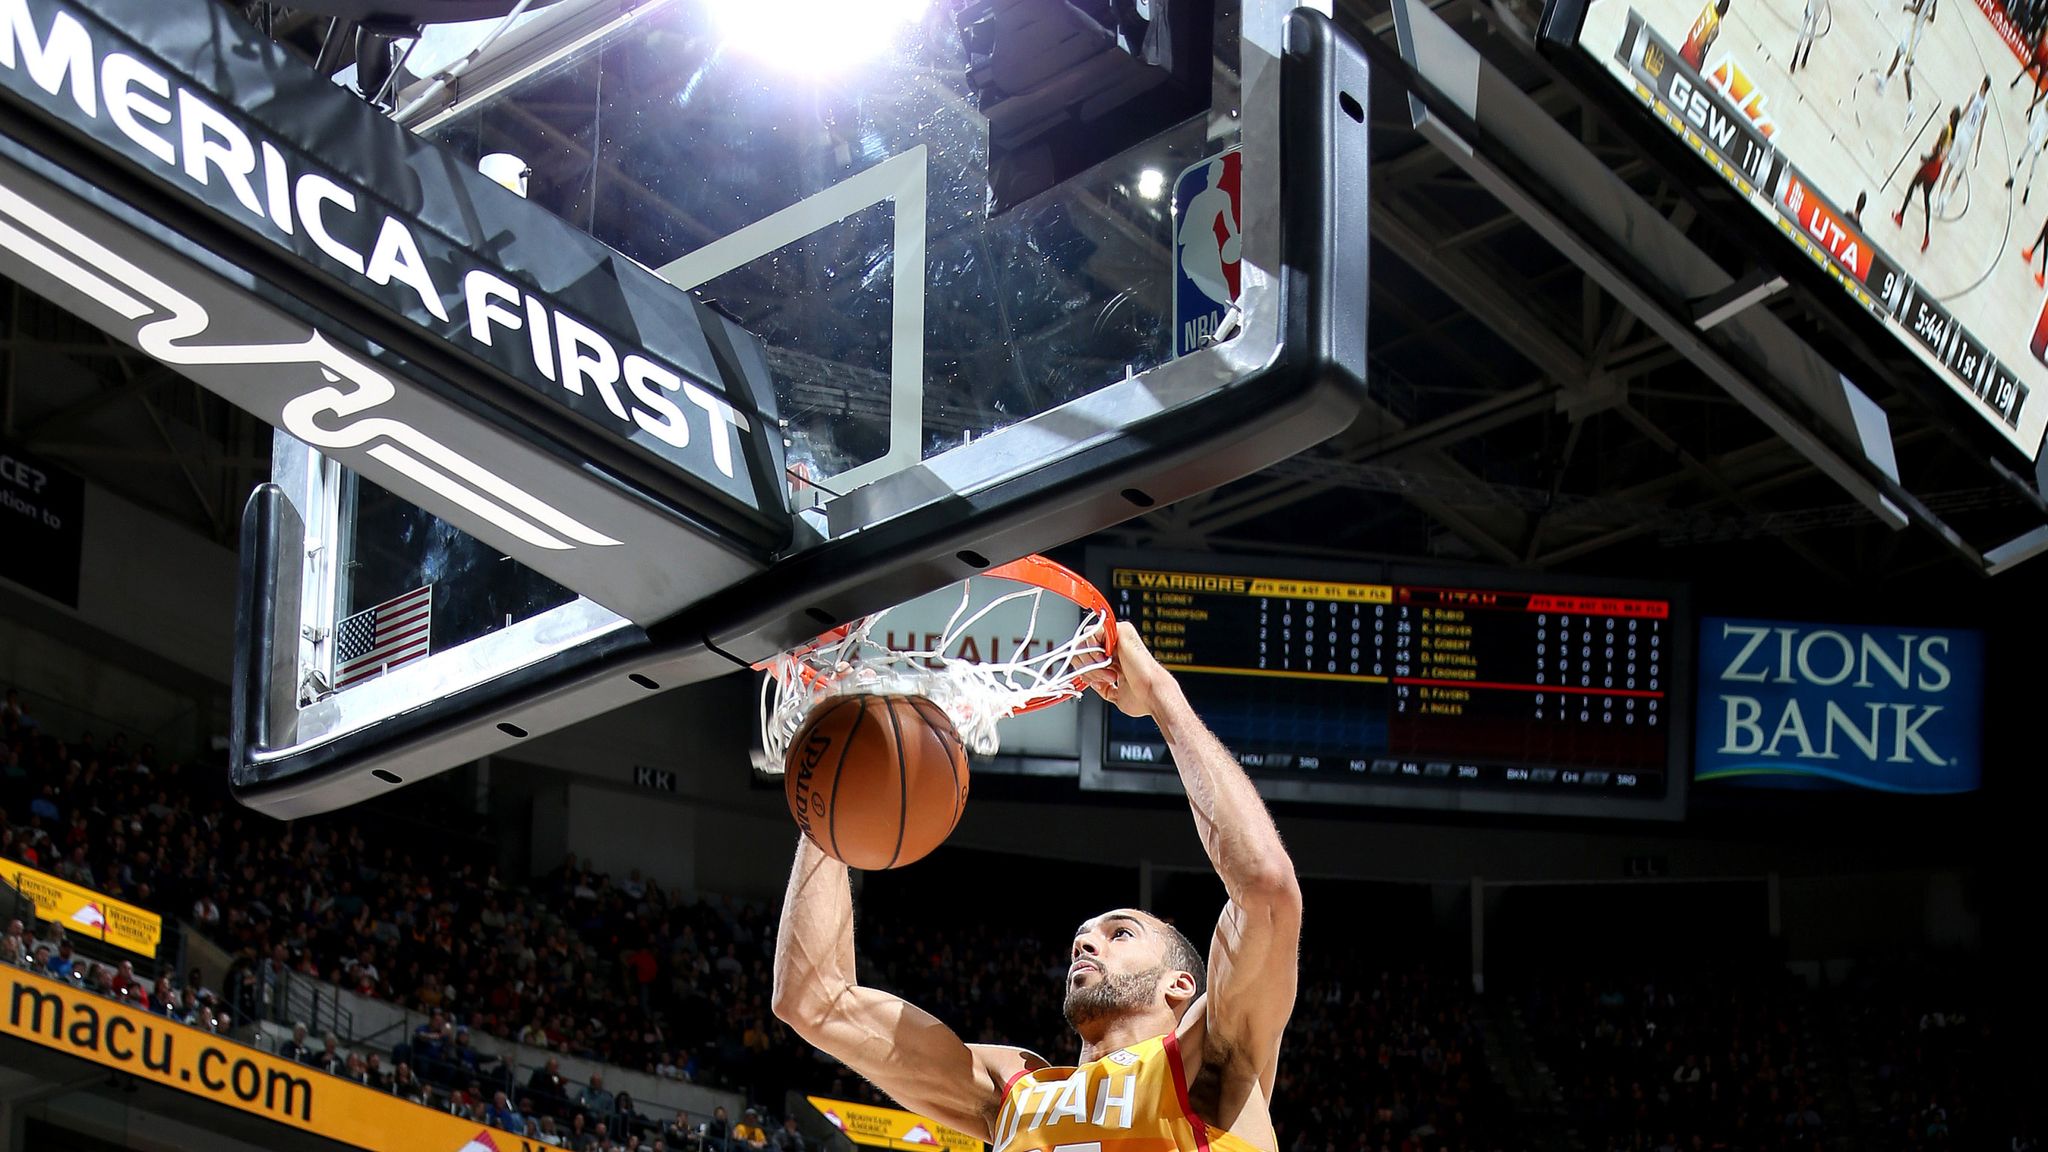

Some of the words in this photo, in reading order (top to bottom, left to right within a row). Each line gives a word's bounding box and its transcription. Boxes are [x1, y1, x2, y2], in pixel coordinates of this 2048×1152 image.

[1667, 71, 1737, 150] GSW
[1742, 145, 1762, 180] 11
[1809, 207, 1859, 275] UTA
[1881, 272, 1896, 300] 9
[1184, 310, 1219, 352] NBA
[1914, 301, 1945, 346] 5:44
[1954, 341, 1977, 379] 1st
[1994, 376, 2013, 410] 19
[464, 269, 750, 480] FIRST
[0, 488, 36, 518] tion
[42, 507, 60, 529] to
[1138, 573, 1246, 592] WARRIORS
[1440, 591, 1497, 603] UTAH
[1720, 622, 1951, 692] ZIONS
[1120, 744, 1153, 762] NBA
[1717, 694, 1948, 766] BANK
[638, 767, 669, 790] KK
[1240, 754, 1264, 766] HOU
[1350, 760, 1366, 771] NO
[1458, 766, 1478, 778] 3RD
[1506, 768, 1528, 781] BKN
[1616, 774, 1636, 786] 3RD
[796, 735, 831, 848] SPALDIN
[9, 980, 313, 1122] macu.com
[992, 1071, 1137, 1152] UTAH
